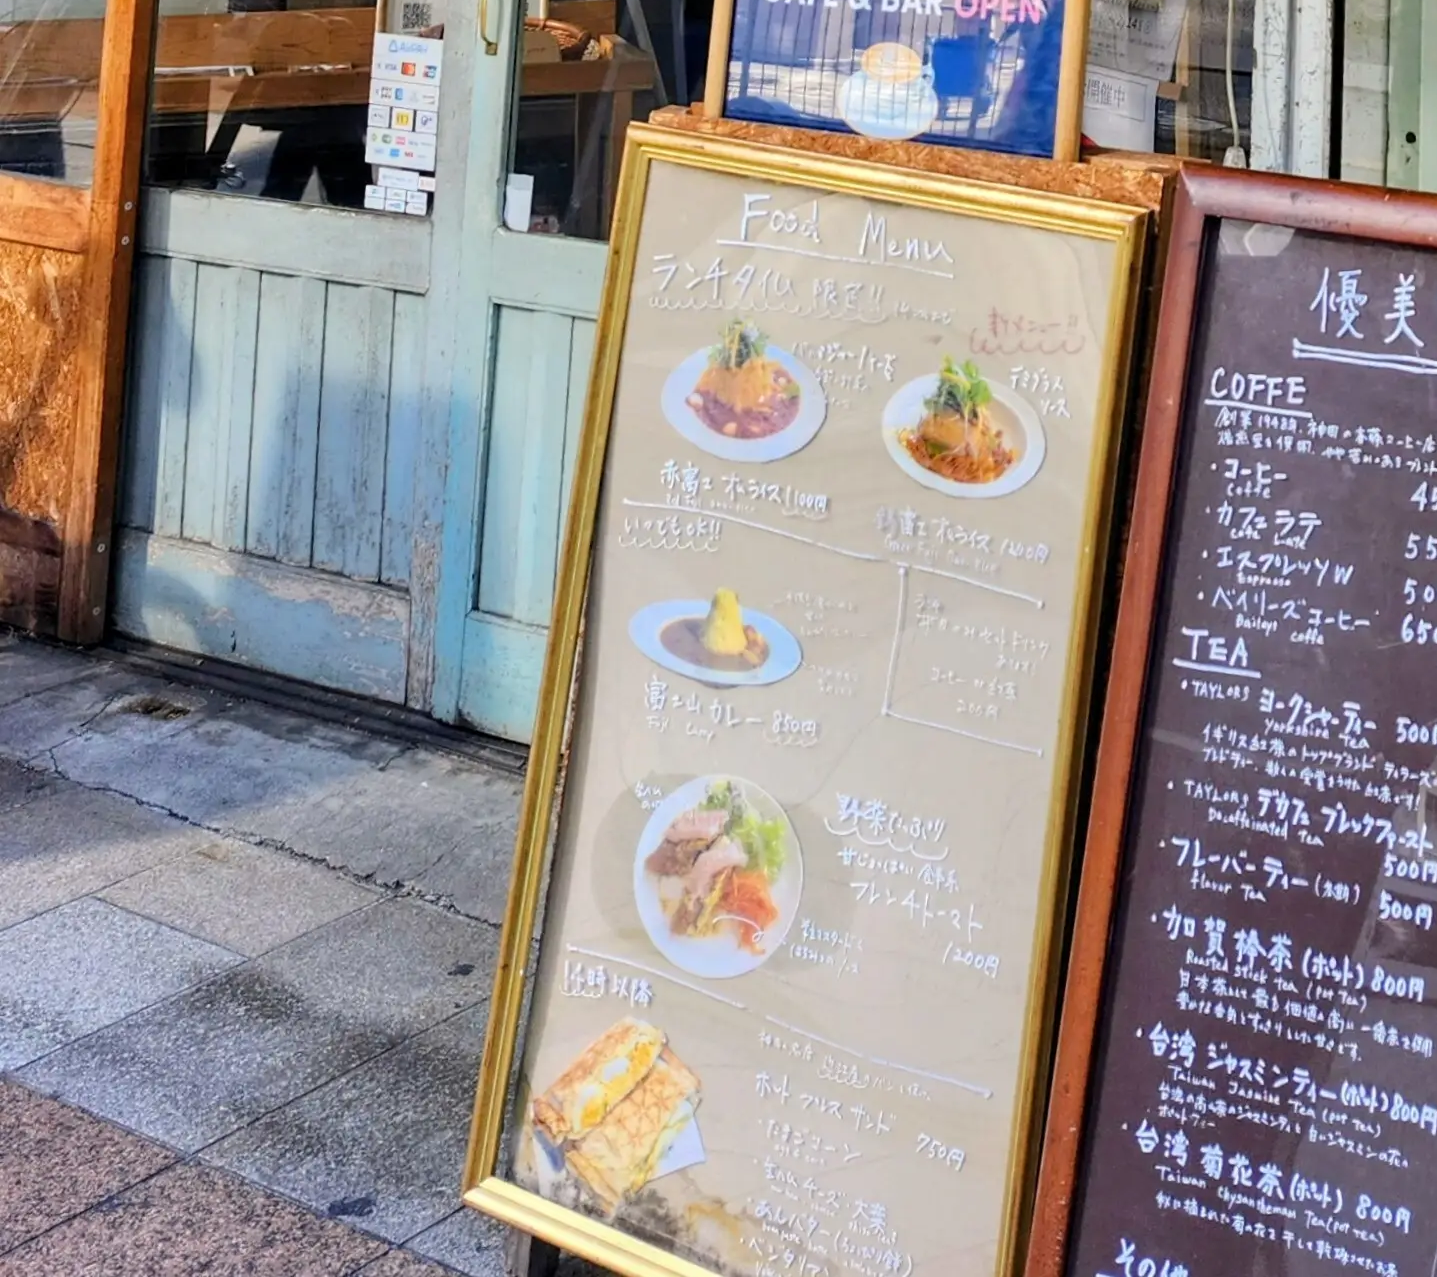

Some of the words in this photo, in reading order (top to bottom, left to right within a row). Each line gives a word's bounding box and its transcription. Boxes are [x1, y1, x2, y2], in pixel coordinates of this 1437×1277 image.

[741, 193, 822, 243] Food
[858, 211, 954, 263] Menu
[1210, 366, 1308, 405] COFFE
[1223, 458, 1288, 486] コーヒー
[1181, 626, 1250, 668] TEA
[1191, 679, 1251, 702] TAYLORS
[1183, 779, 1250, 808] TAYLORS
[1378, 889, 1434, 931] 500円
[1370, 968, 1425, 1003] 800円
[1354, 1195, 1412, 1234] 800円
